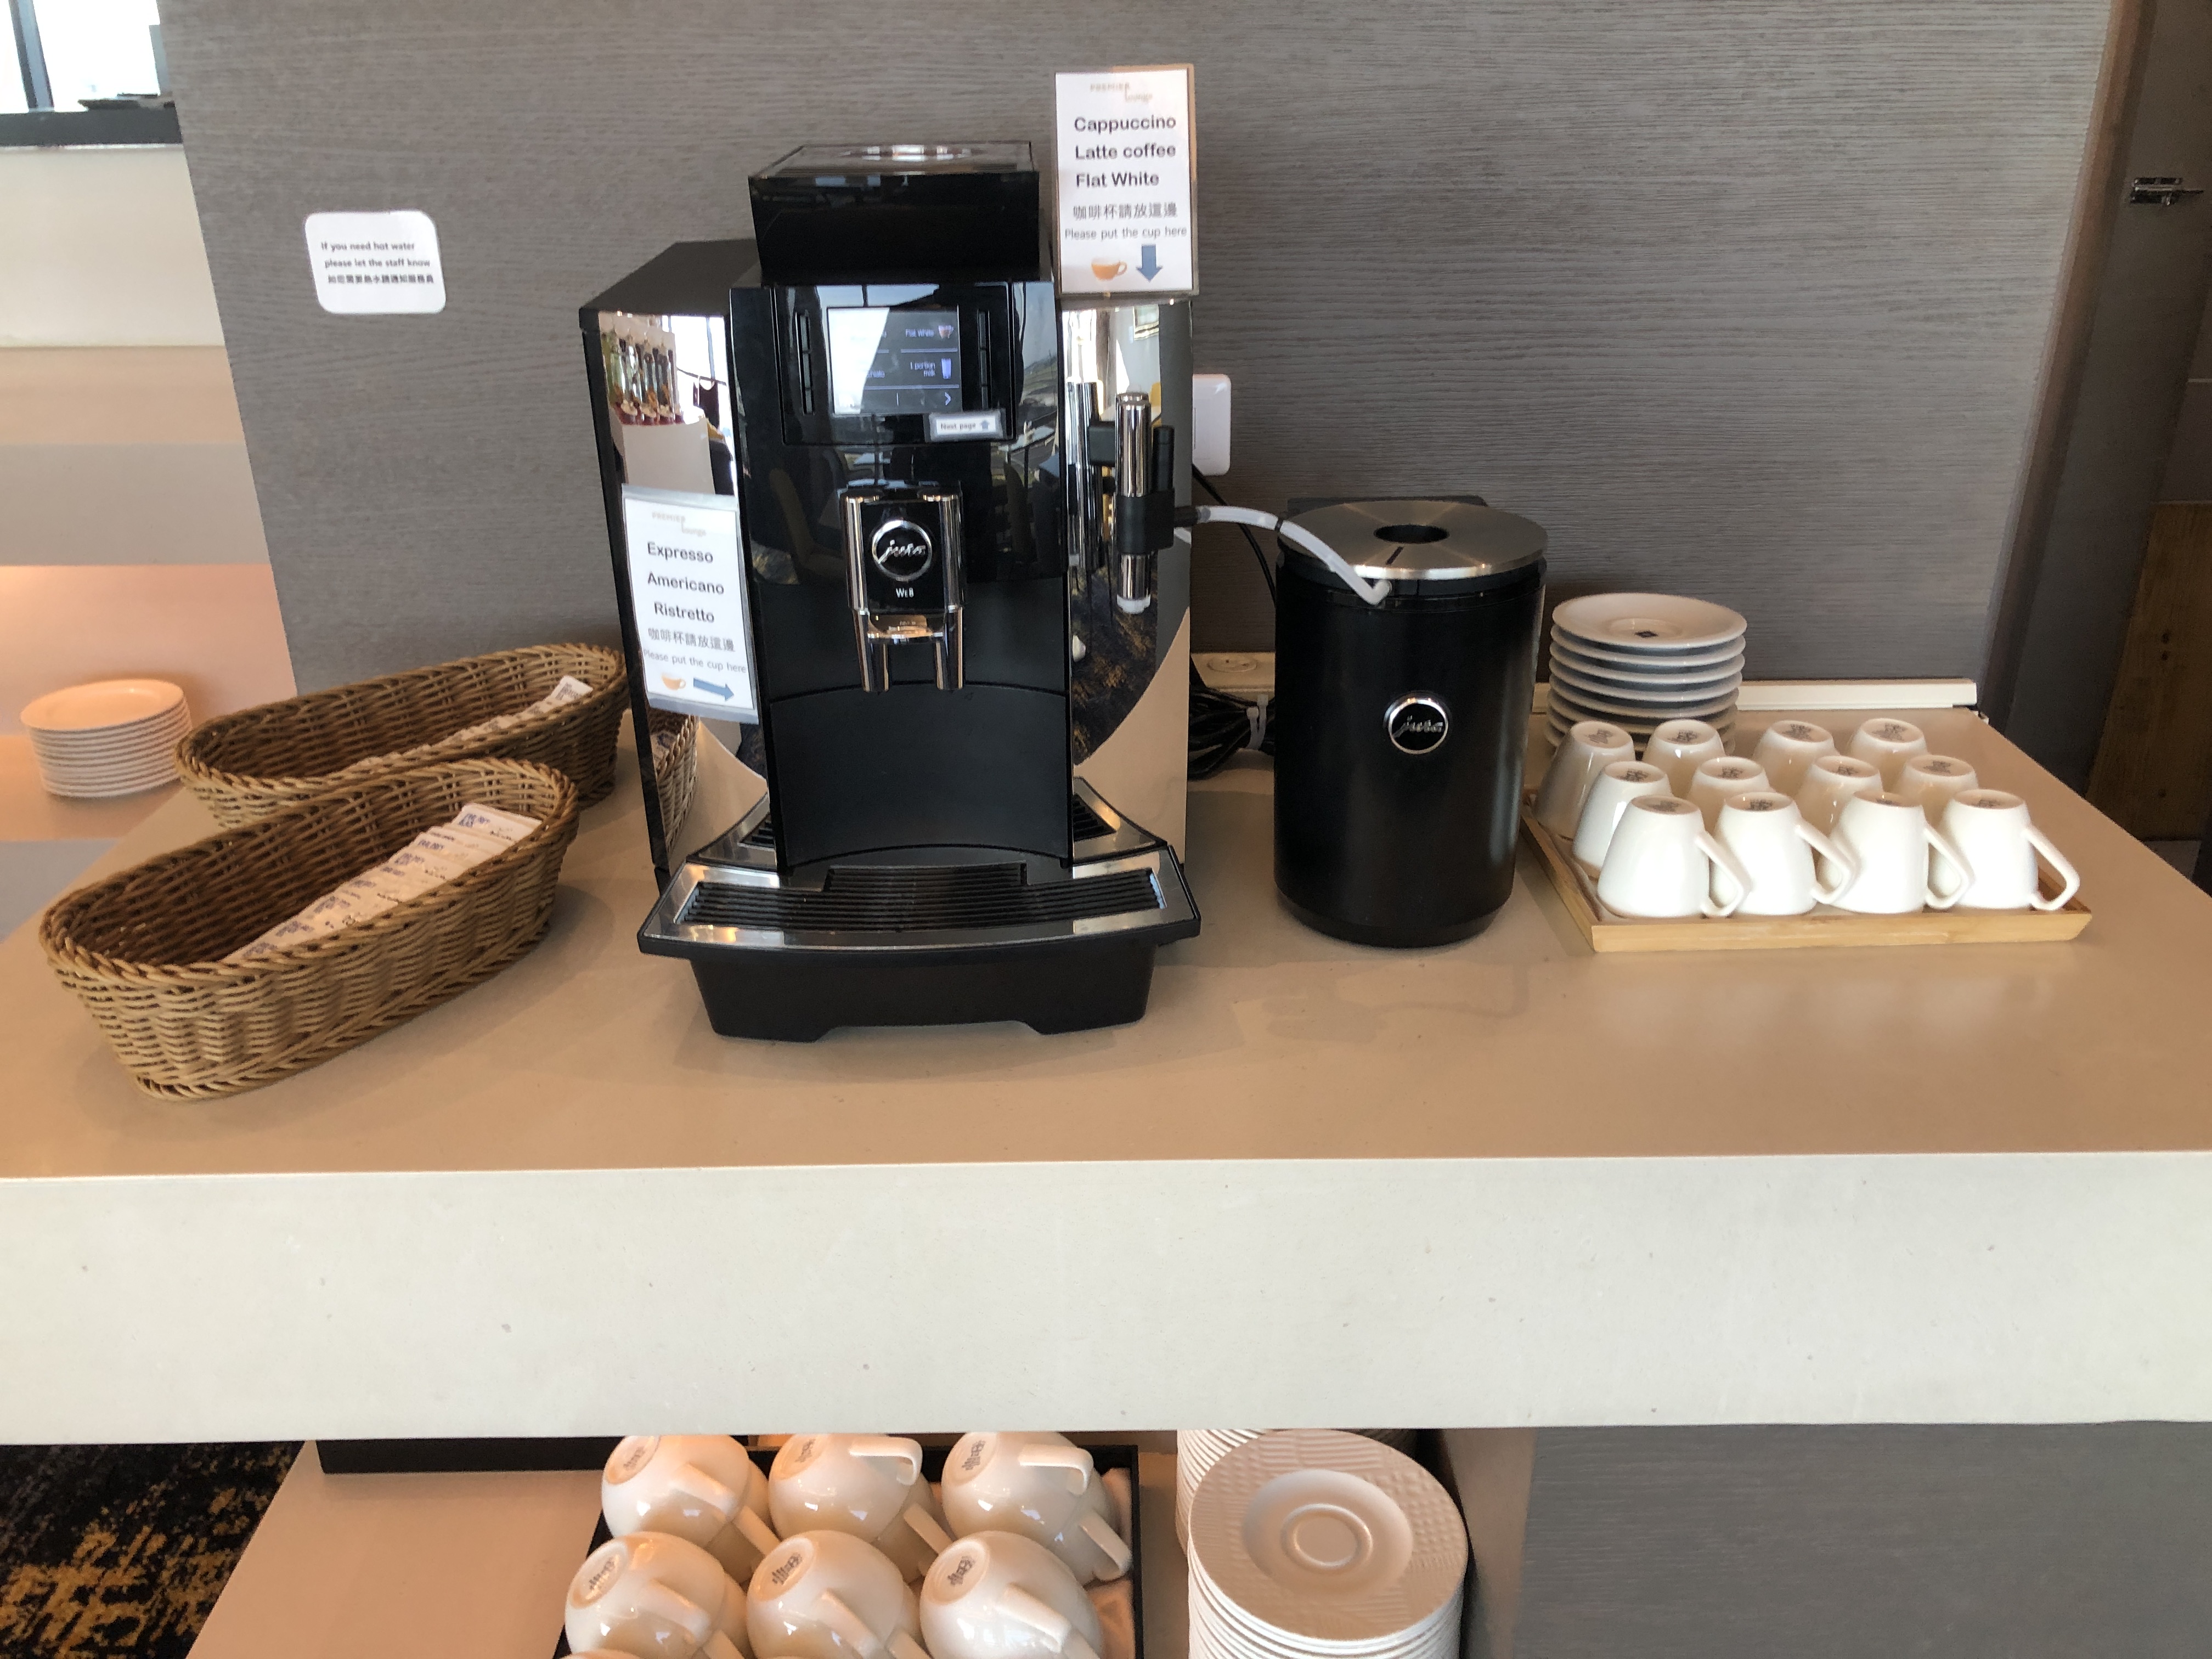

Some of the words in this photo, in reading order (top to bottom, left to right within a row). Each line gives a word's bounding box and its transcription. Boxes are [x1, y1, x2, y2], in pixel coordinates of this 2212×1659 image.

[1074, 114, 1176, 135] Cappuccino
[1075, 144, 1118, 160] Latte
[1122, 142, 1176, 158] coffee
[1076, 172, 1107, 188] Flat
[1111, 171, 1159, 187] White
[1065, 228, 1097, 240] Please
[1101, 229, 1118, 242] put
[1122, 227, 1138, 239] the
[1142, 227, 1161, 240] cup
[1164, 225, 1187, 238] here
[330, 242, 347, 252] you
[350, 241, 371, 251] need
[373, 241, 388, 251] hot
[391, 242, 414, 251] water
[324, 259, 352, 268] please
[354, 258, 366, 267] let
[369, 258, 382, 267] the
[385, 258, 404, 268] staff
[407, 258, 430, 267] know
[647, 540, 714, 563] Expresso
[647, 571, 725, 595] Americano
[653, 601, 715, 623] Ristretto
[643, 648, 669, 662] Please
[672, 655, 687, 665] put
[690, 656, 704, 668] the
[707, 660, 724, 672] cup
[726, 661, 747, 674] here
